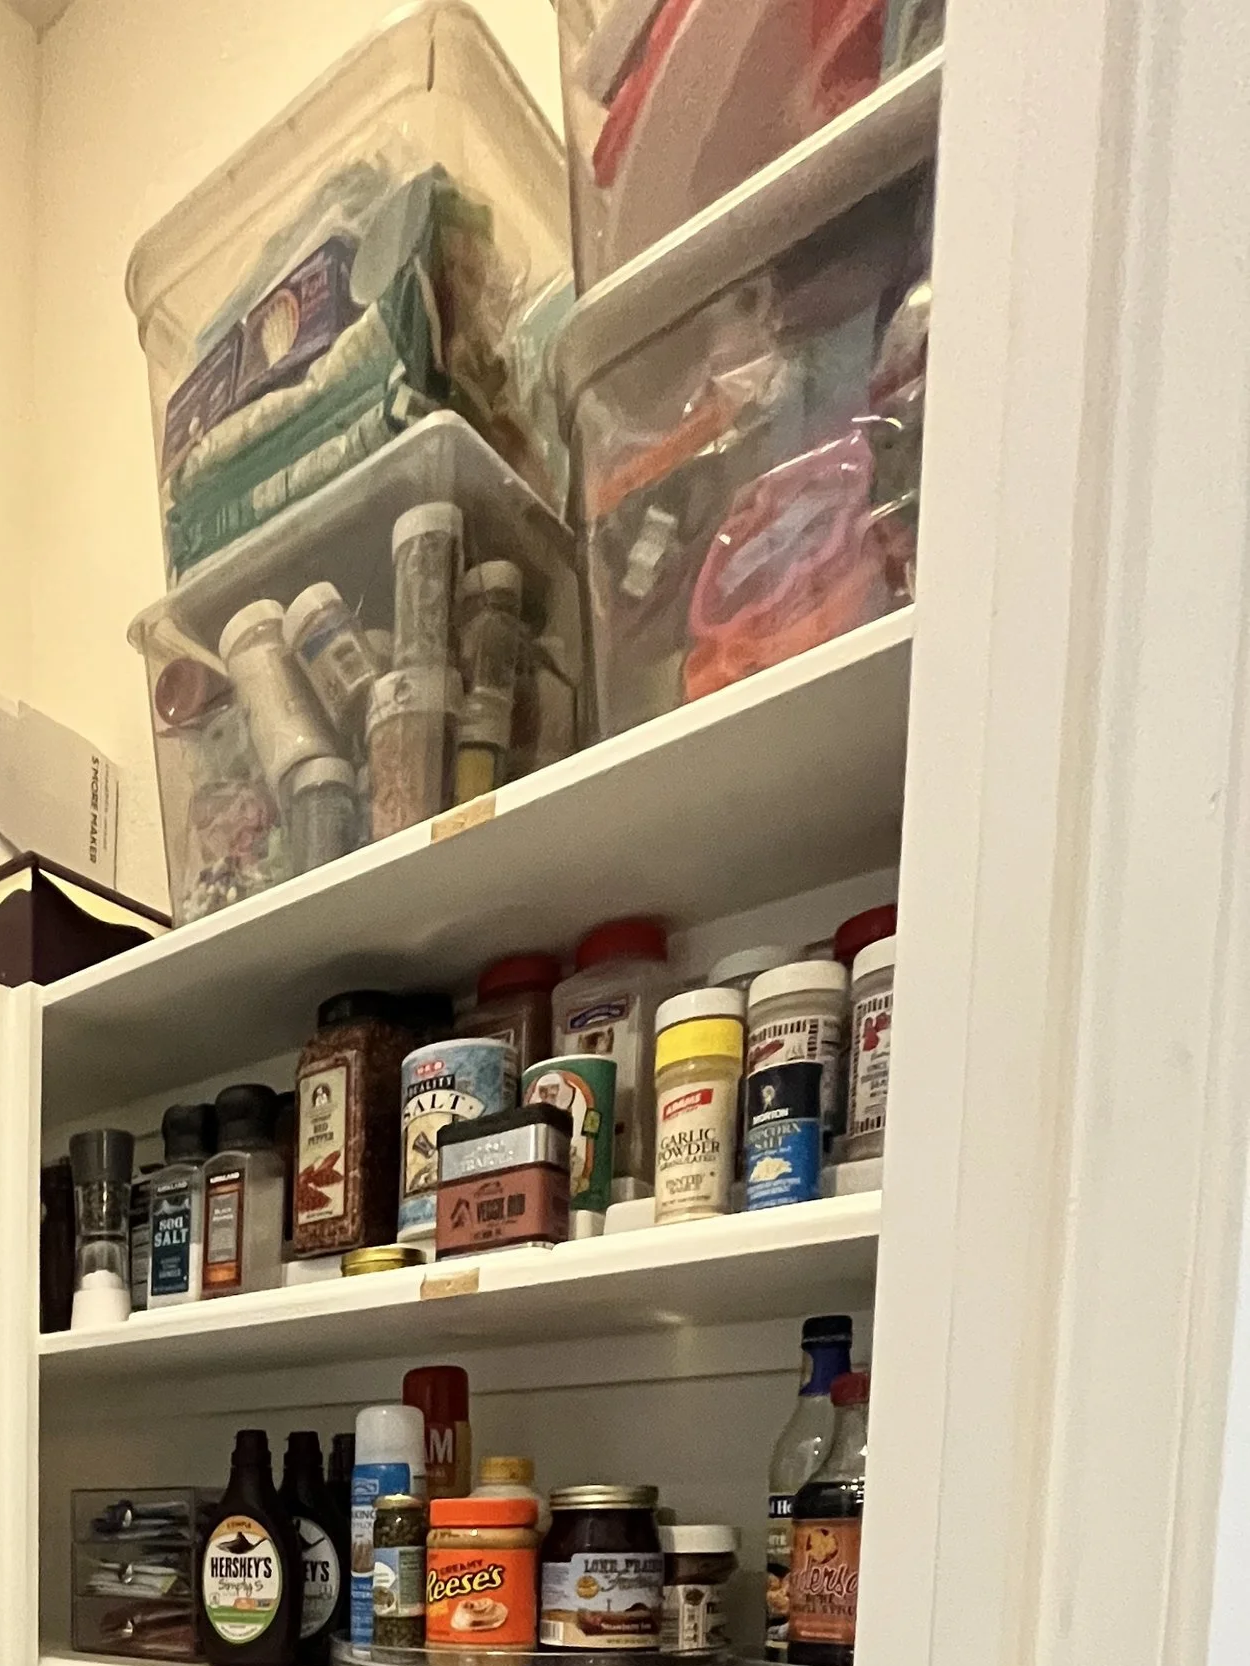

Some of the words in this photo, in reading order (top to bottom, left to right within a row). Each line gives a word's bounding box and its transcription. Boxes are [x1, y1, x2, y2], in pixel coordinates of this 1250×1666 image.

[660, 1127, 716, 1149] GARLIC
[658, 1141, 720, 1163] POWDER
[154, 1228, 189, 1248] SALT
[210, 1556, 272, 1579] HERSHEY'S
